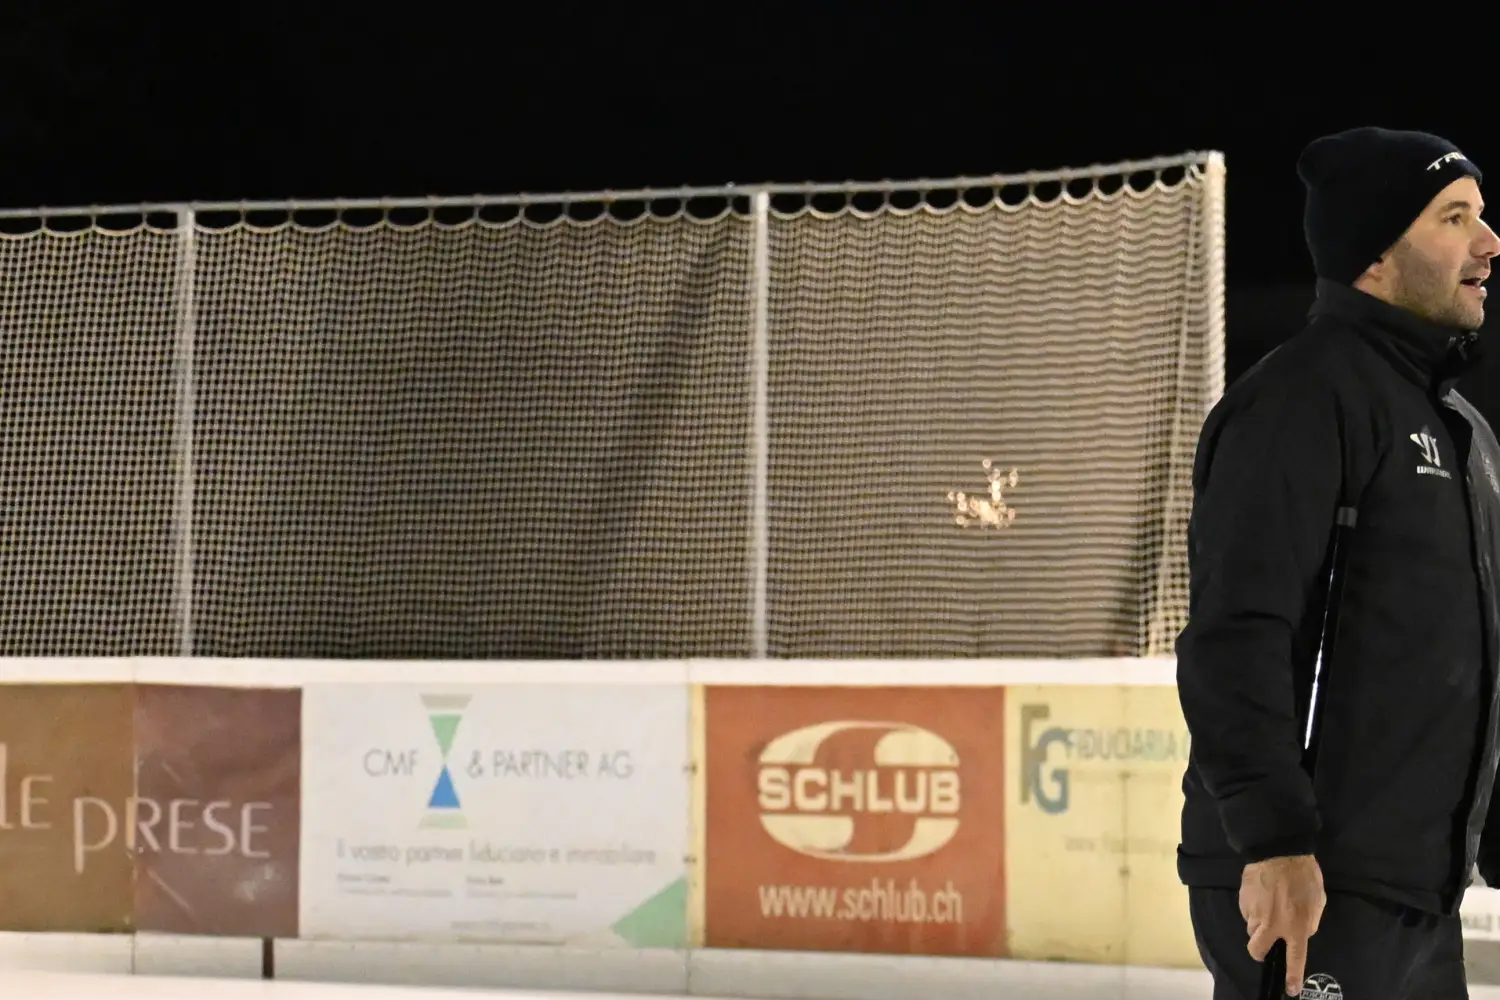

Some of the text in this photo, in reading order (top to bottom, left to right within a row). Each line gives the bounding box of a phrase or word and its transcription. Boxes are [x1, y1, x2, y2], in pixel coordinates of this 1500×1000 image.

[363, 749, 633, 780] CMF & PARTNER AG
[758, 766, 961, 813] SCHLUB
[758, 879, 963, 924] www.schlub.ch
